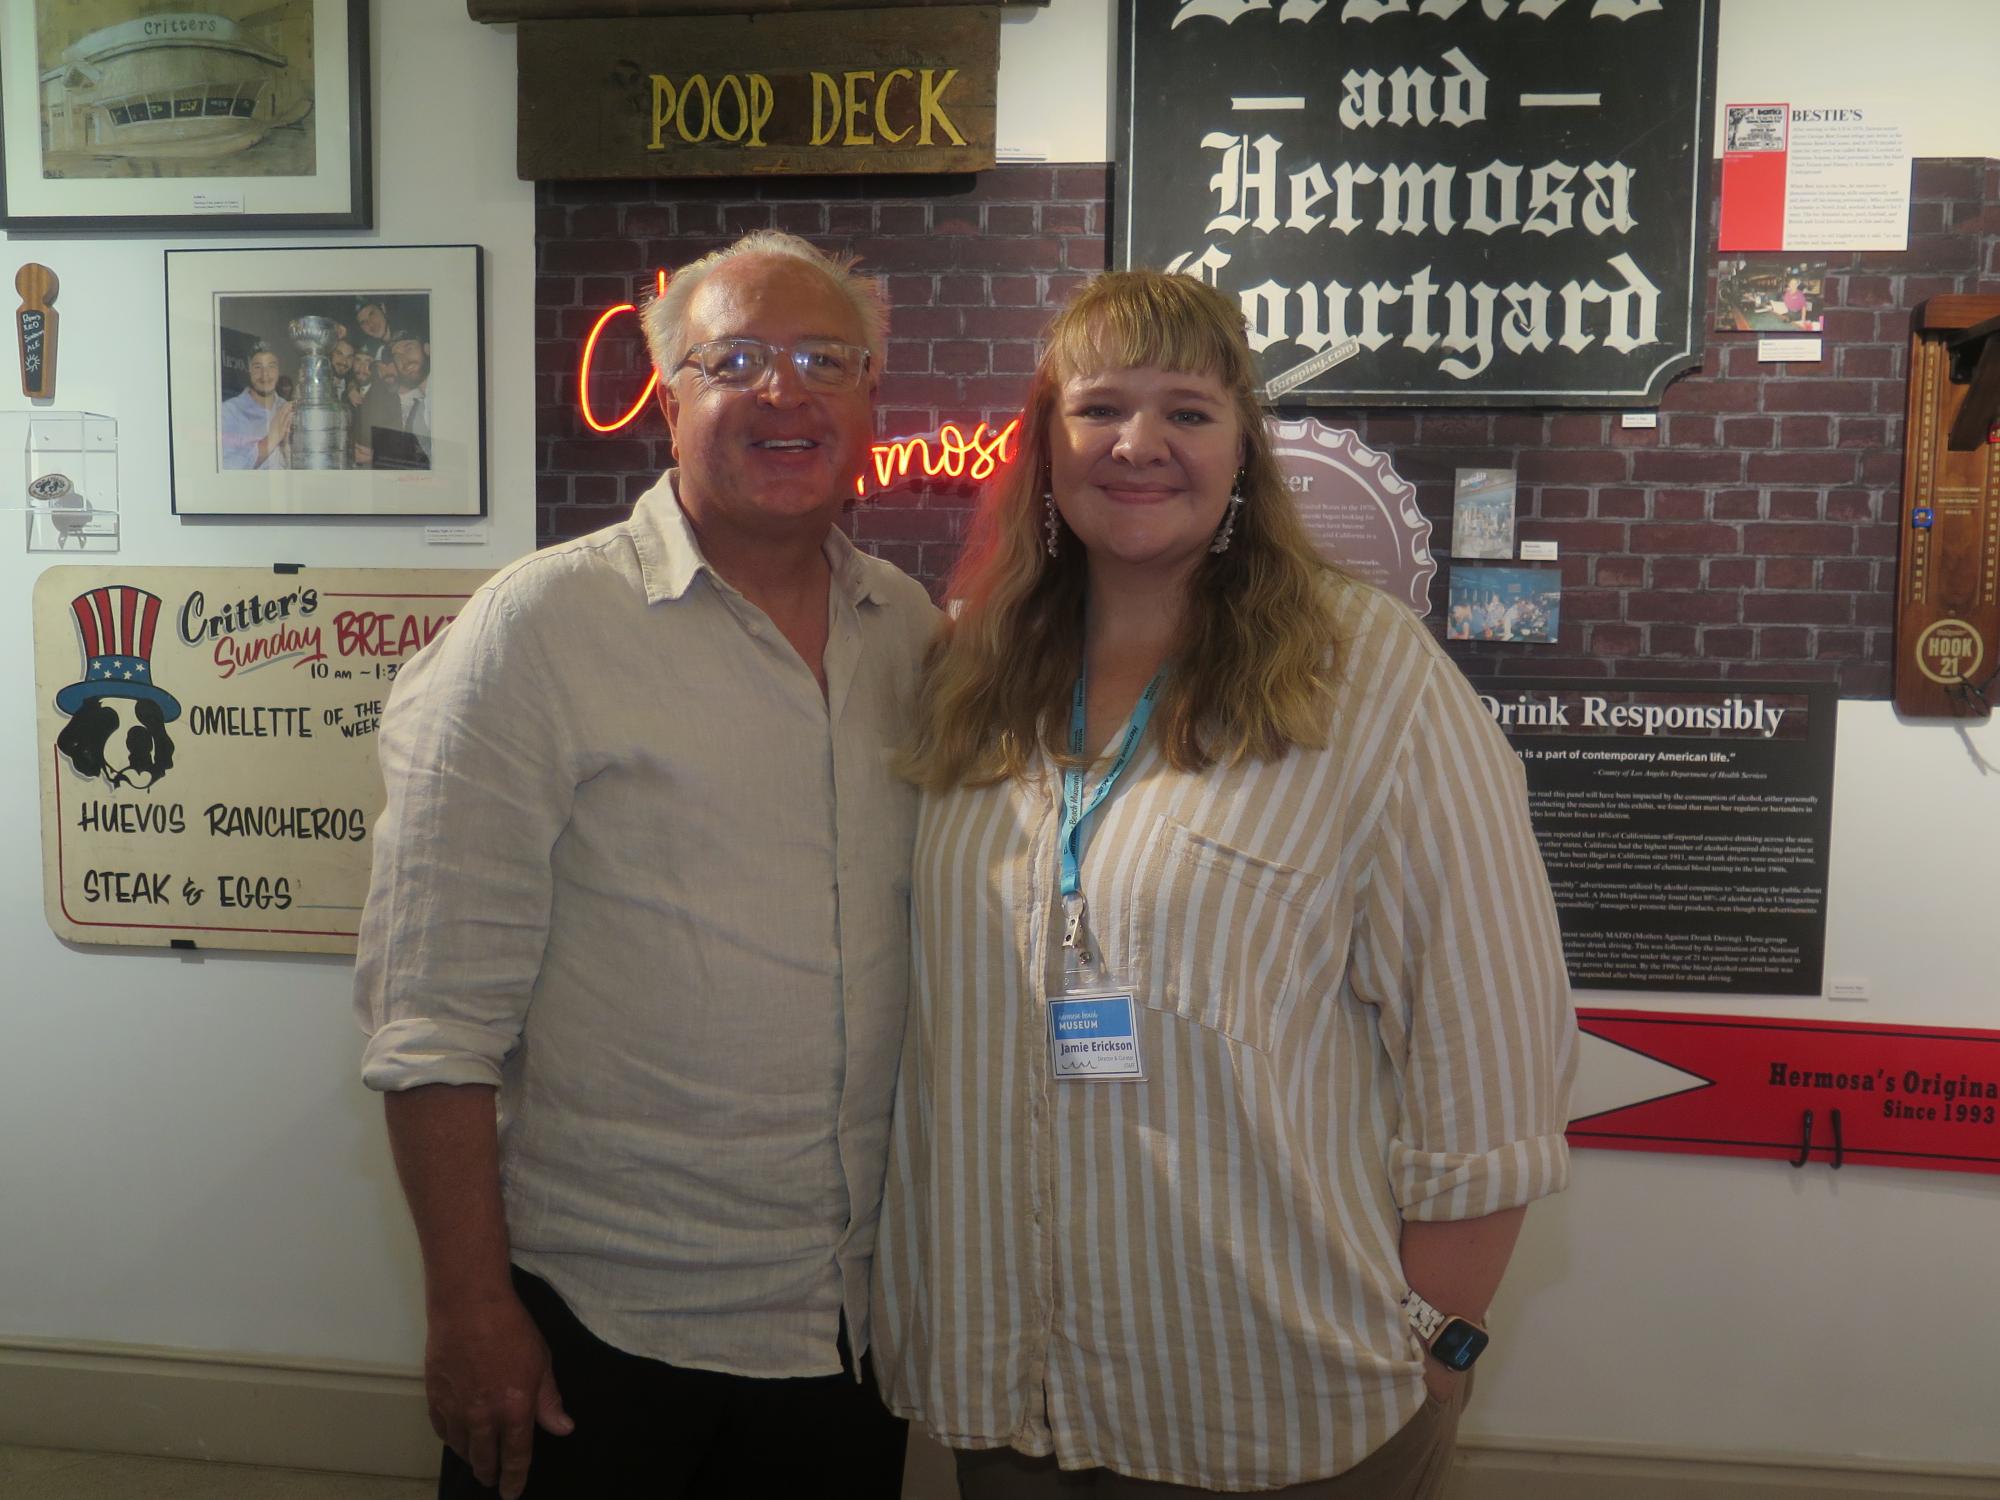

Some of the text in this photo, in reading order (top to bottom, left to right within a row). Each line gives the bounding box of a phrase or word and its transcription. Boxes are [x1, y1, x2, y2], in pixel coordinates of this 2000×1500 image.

[144, 19, 217, 35] Critters
[1338, 46, 1490, 130] and
[647, 68, 967, 149] POOP DECK
[1792, 109, 1863, 122] BESTIE'S
[1200, 131, 1639, 237] Hermosa
[181, 586, 318, 645] Critter's
[214, 611, 457, 679] Sunday BREAK
[1929, 638, 1972, 656] HOOK
[311, 663, 328, 679] 10
[376, 663, 404, 681] 1:3
[1940, 656, 1958, 676] 21
[190, 700, 382, 738] OMELETTE OF THE
[341, 718, 380, 738] WEEK
[1480, 695, 1786, 738] Drink Responsibly
[1525, 749, 1533, 758] is
[1545, 749, 1566, 762] part
[1569, 749, 1580, 759] of
[1582, 750, 1655, 763] contemporary
[1658, 751, 1707, 761] American
[77, 800, 367, 842] HUEVOS RANCHEROS
[83, 869, 292, 910] STEAK & EGGS
[1059, 1020, 1098, 1030] MUSEUM
[1060, 1041, 1132, 1056] Jamie Erickson
[1768, 1062, 1999, 1101] Hermosa's Origina
[1883, 1099, 1996, 1124] Since 1993
